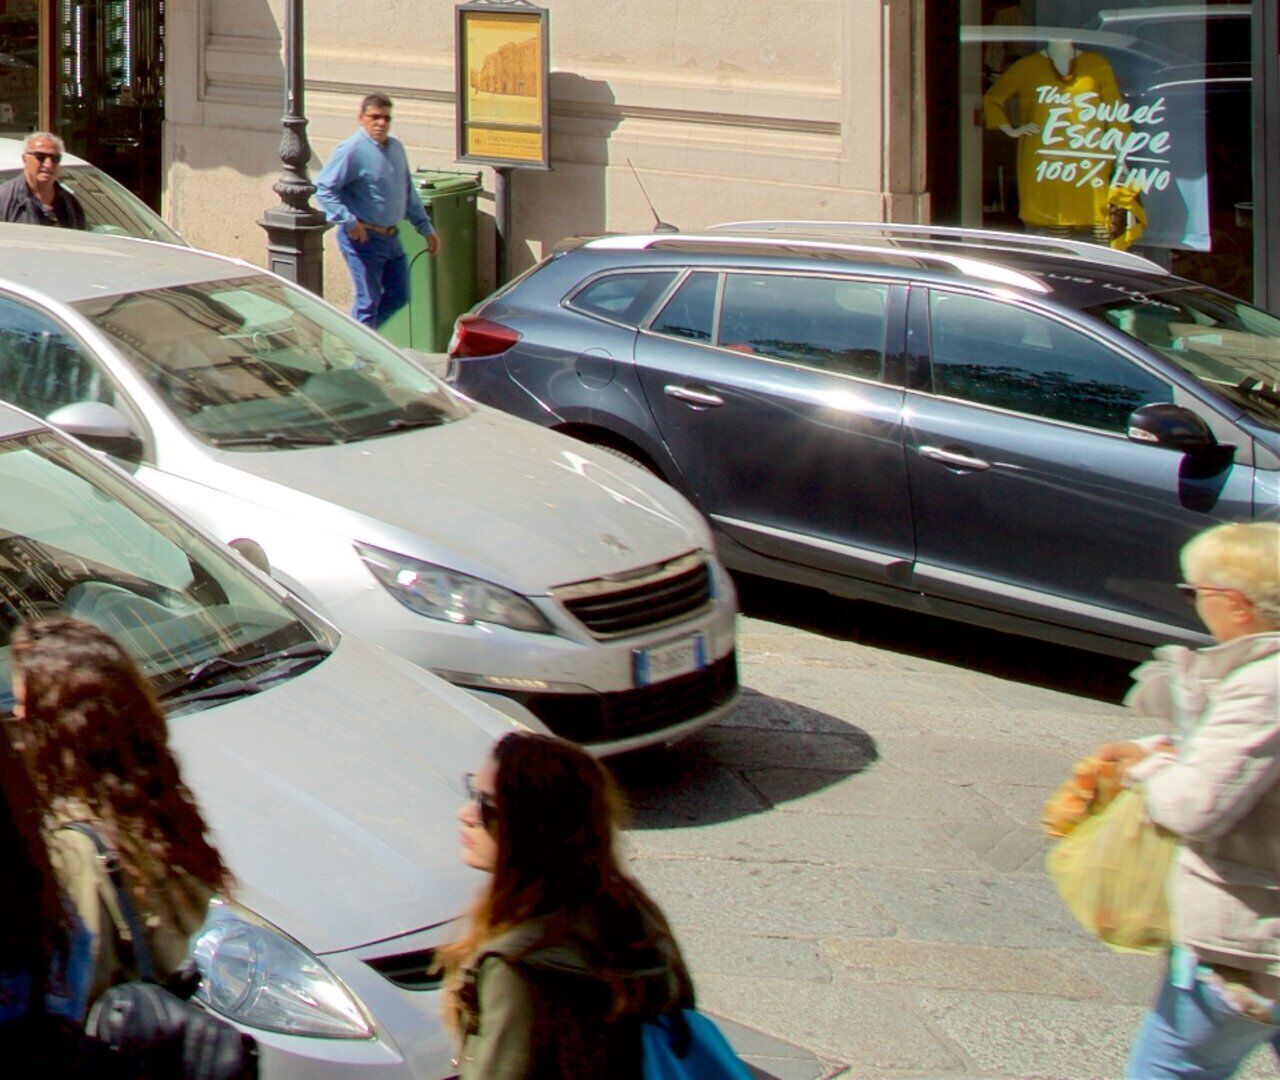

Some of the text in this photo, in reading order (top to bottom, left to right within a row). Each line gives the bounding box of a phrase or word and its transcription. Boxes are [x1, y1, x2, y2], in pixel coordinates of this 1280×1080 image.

[1036, 85, 1166, 124] The Sweet
[1042, 107, 1171, 164] Escape
[1036, 159, 1170, 195] 100% LINO
